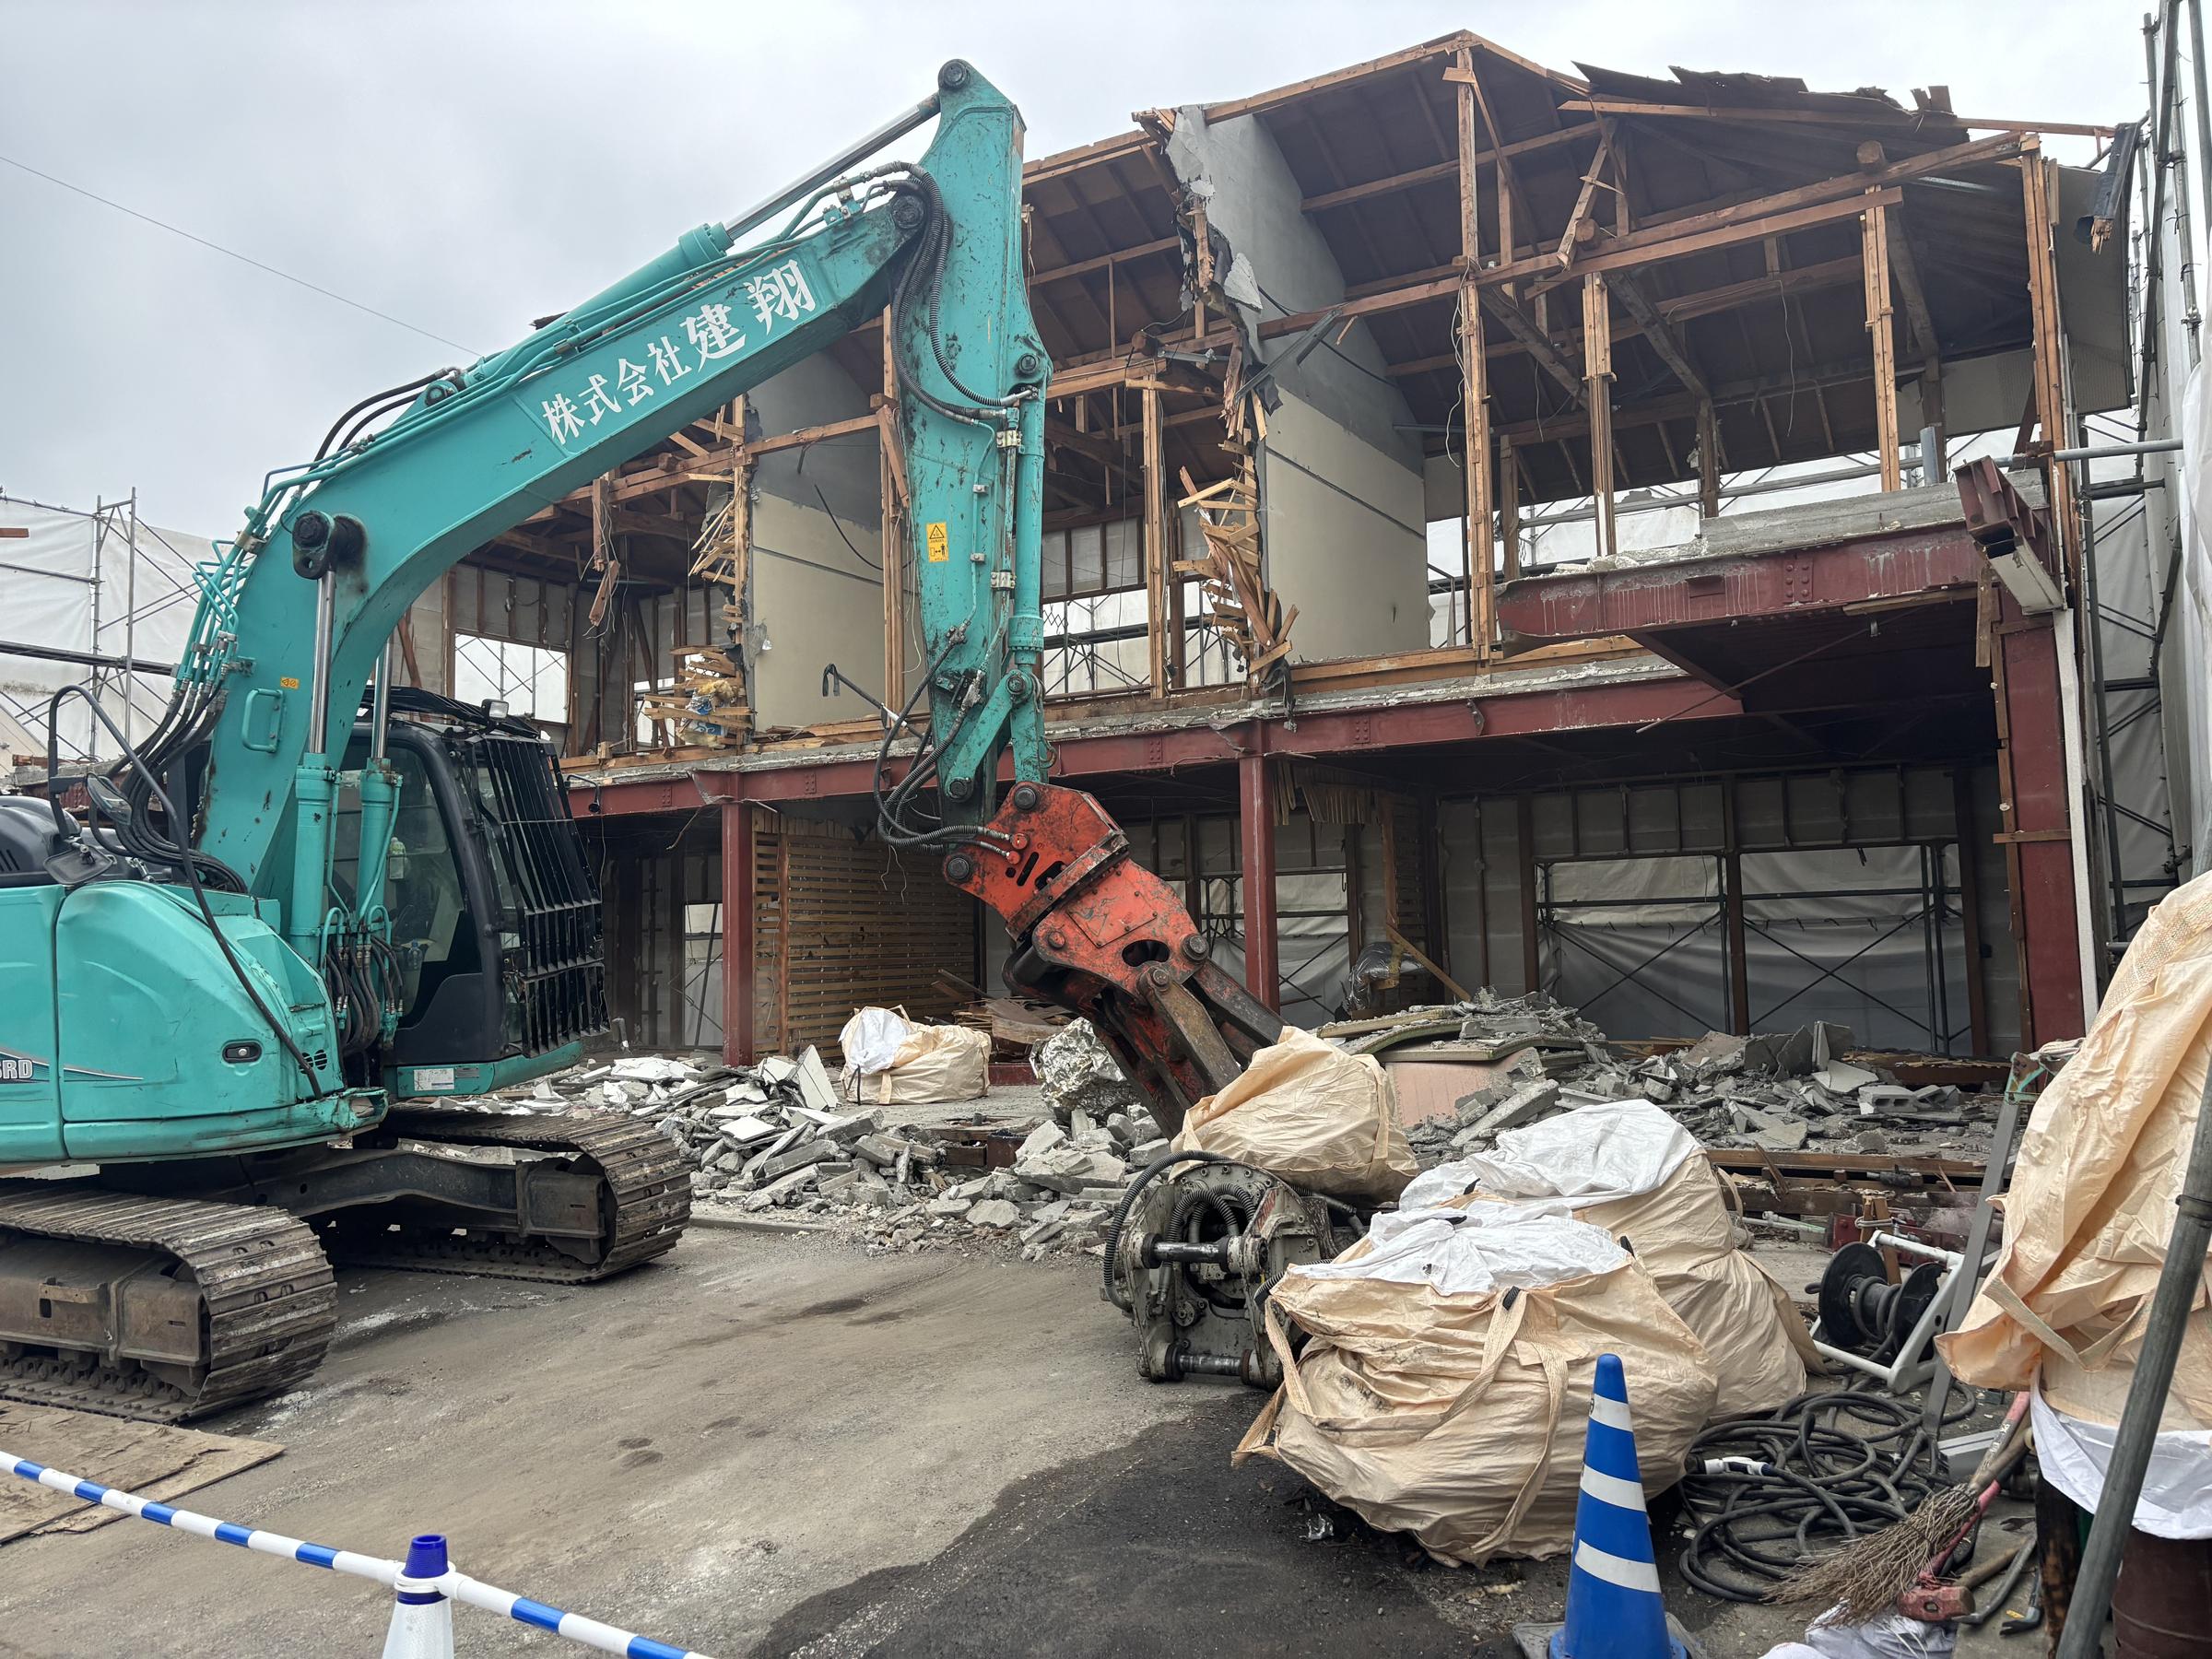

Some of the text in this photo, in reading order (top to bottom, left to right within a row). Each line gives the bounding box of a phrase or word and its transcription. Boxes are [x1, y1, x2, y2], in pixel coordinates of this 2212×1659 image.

[542, 259, 816, 444] 株式会社建翔
[0, 1059, 33, 1079] RD
